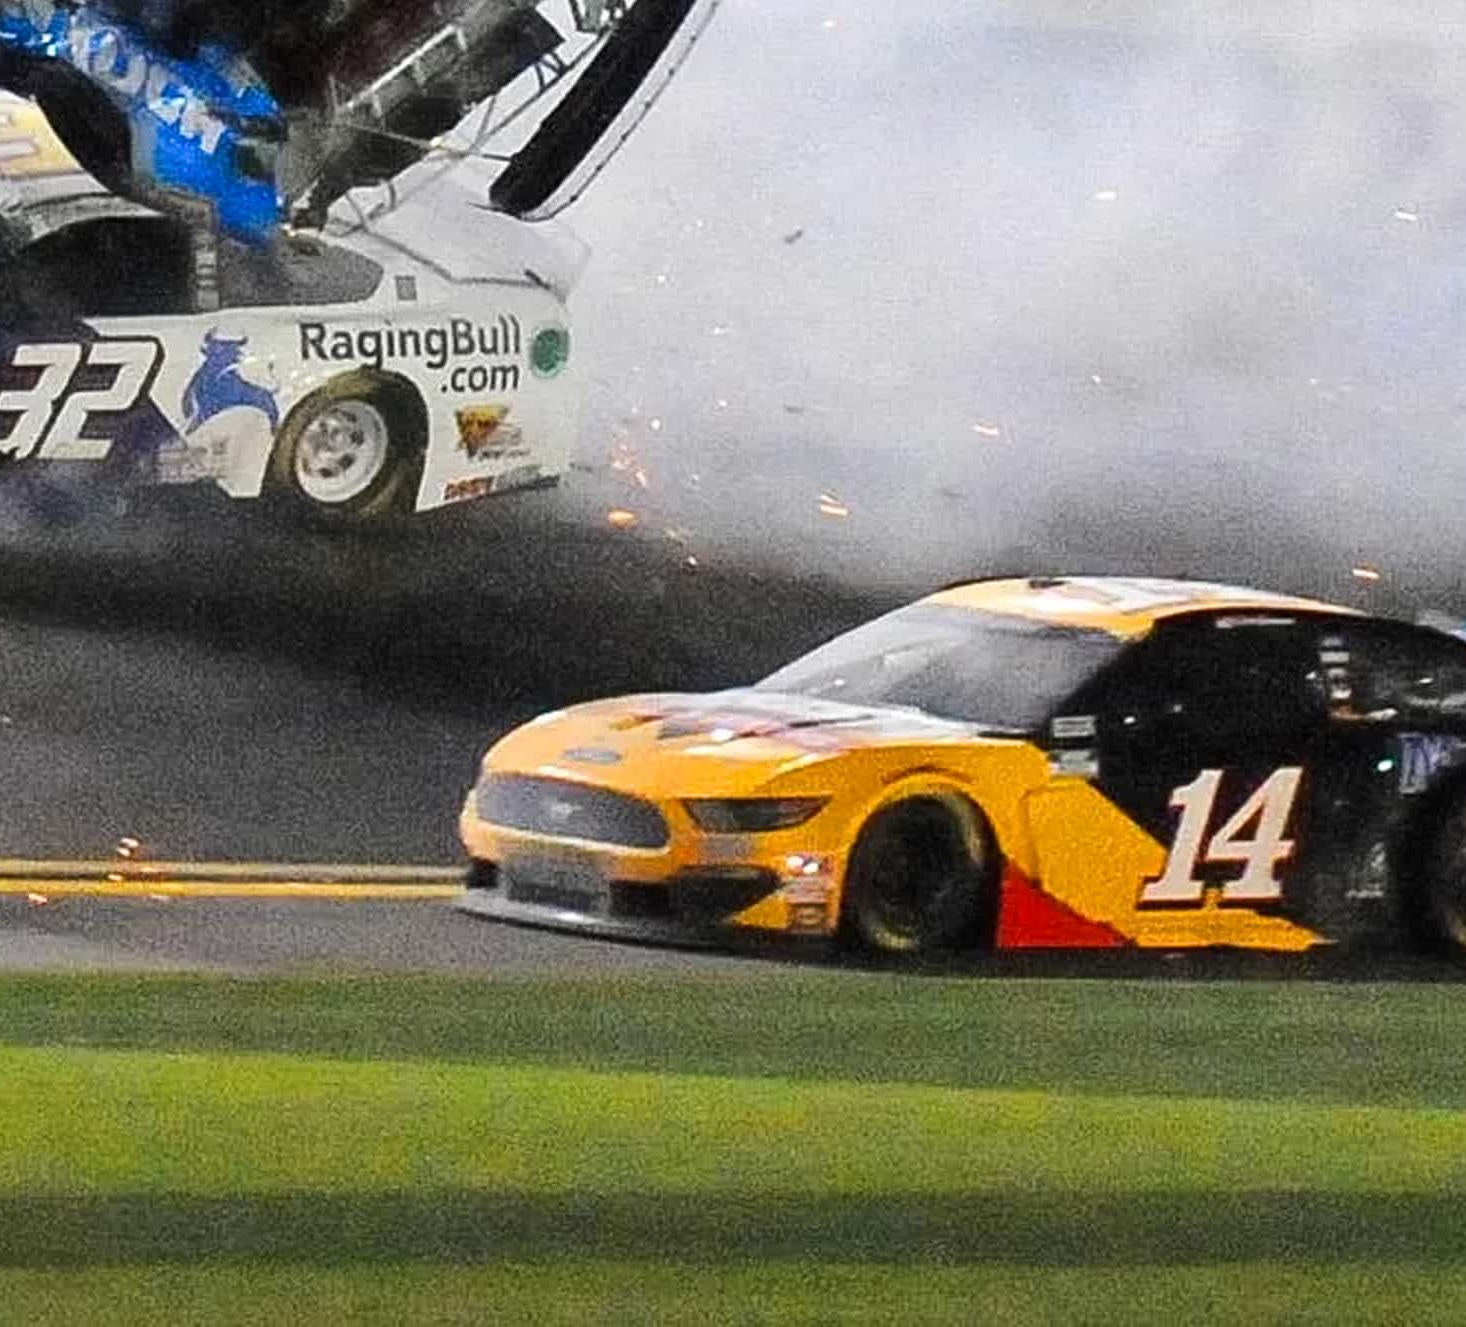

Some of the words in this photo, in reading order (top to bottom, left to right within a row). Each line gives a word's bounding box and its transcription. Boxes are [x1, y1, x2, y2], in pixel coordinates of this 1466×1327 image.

[300, 313, 520, 368] RagingBull
[440, 362, 519, 393] .com
[1139, 768, 1303, 904] 14
